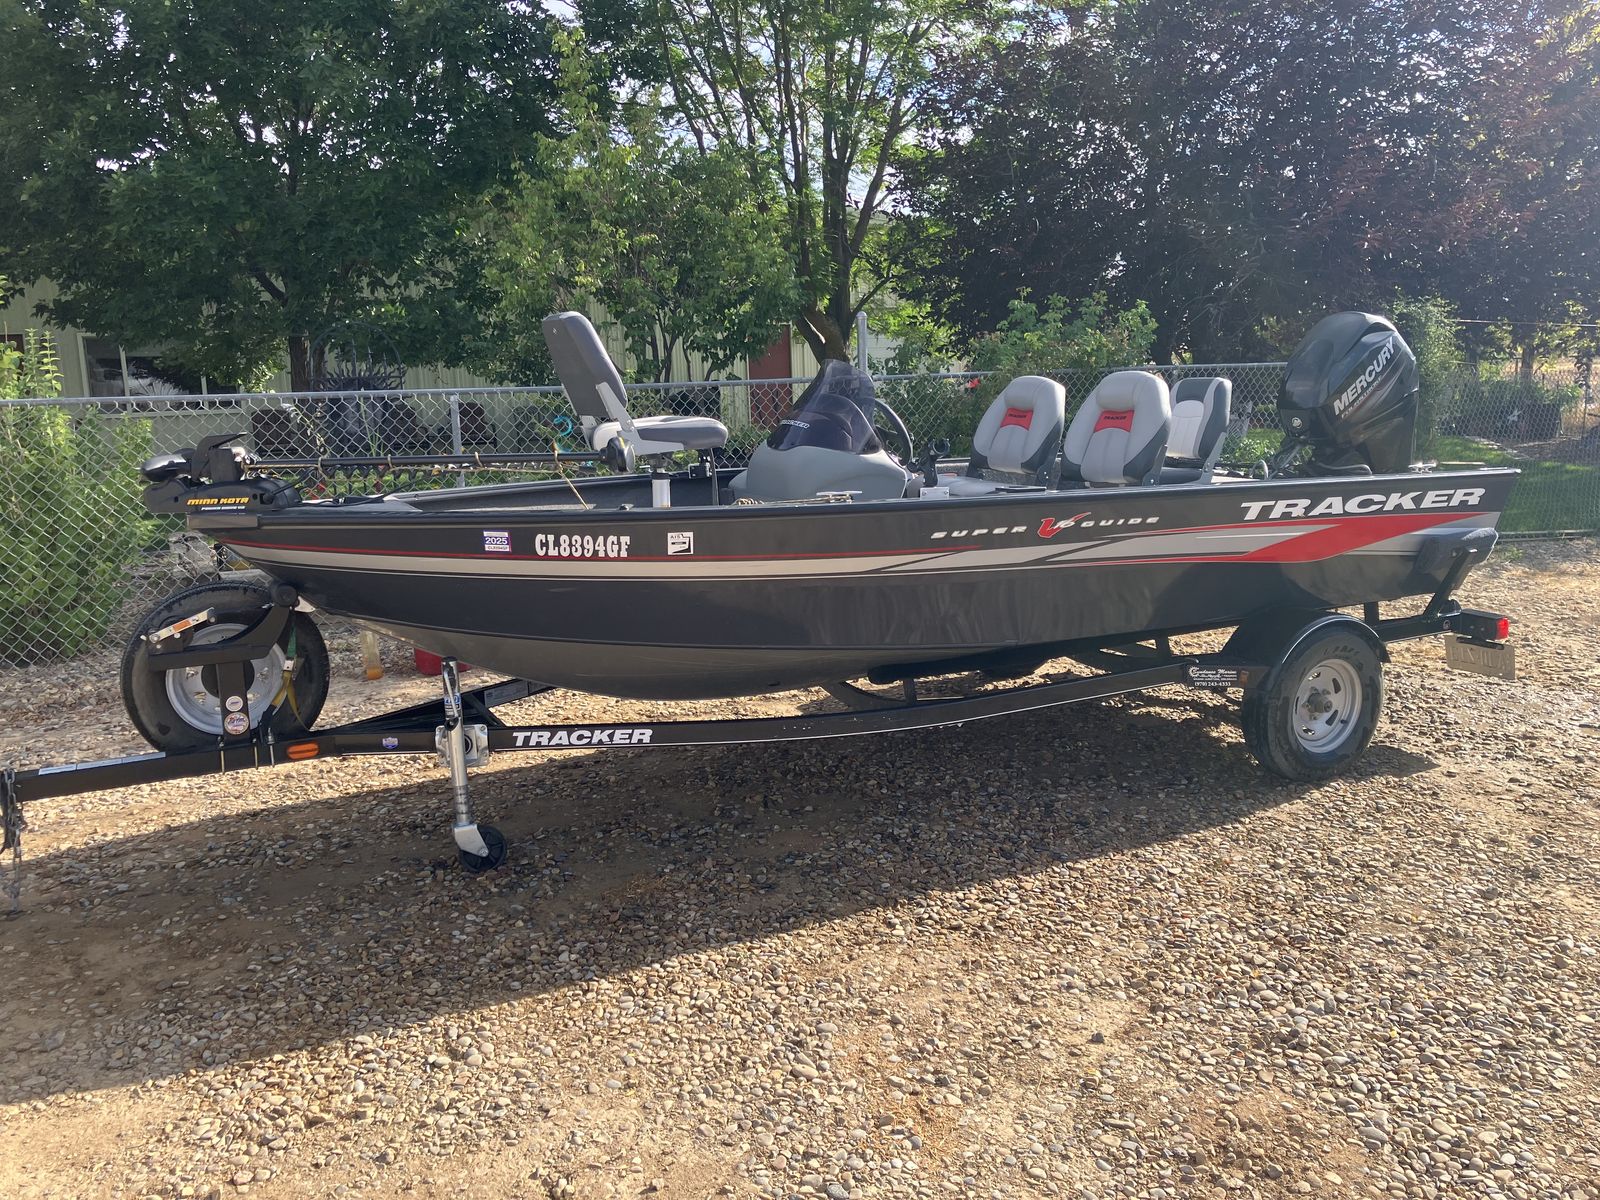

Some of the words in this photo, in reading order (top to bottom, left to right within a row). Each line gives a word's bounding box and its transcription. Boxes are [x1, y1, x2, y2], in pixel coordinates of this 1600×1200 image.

[1333, 336, 1396, 416] MERCURY
[1240, 488, 1486, 521] TRACKER
[930, 525, 1028, 540] SUPER
[1080, 516, 1160, 528] GUIDE
[485, 537, 508, 545] 2025
[534, 533, 631, 558] CL8394GF
[512, 728, 653, 747] TRACKER
